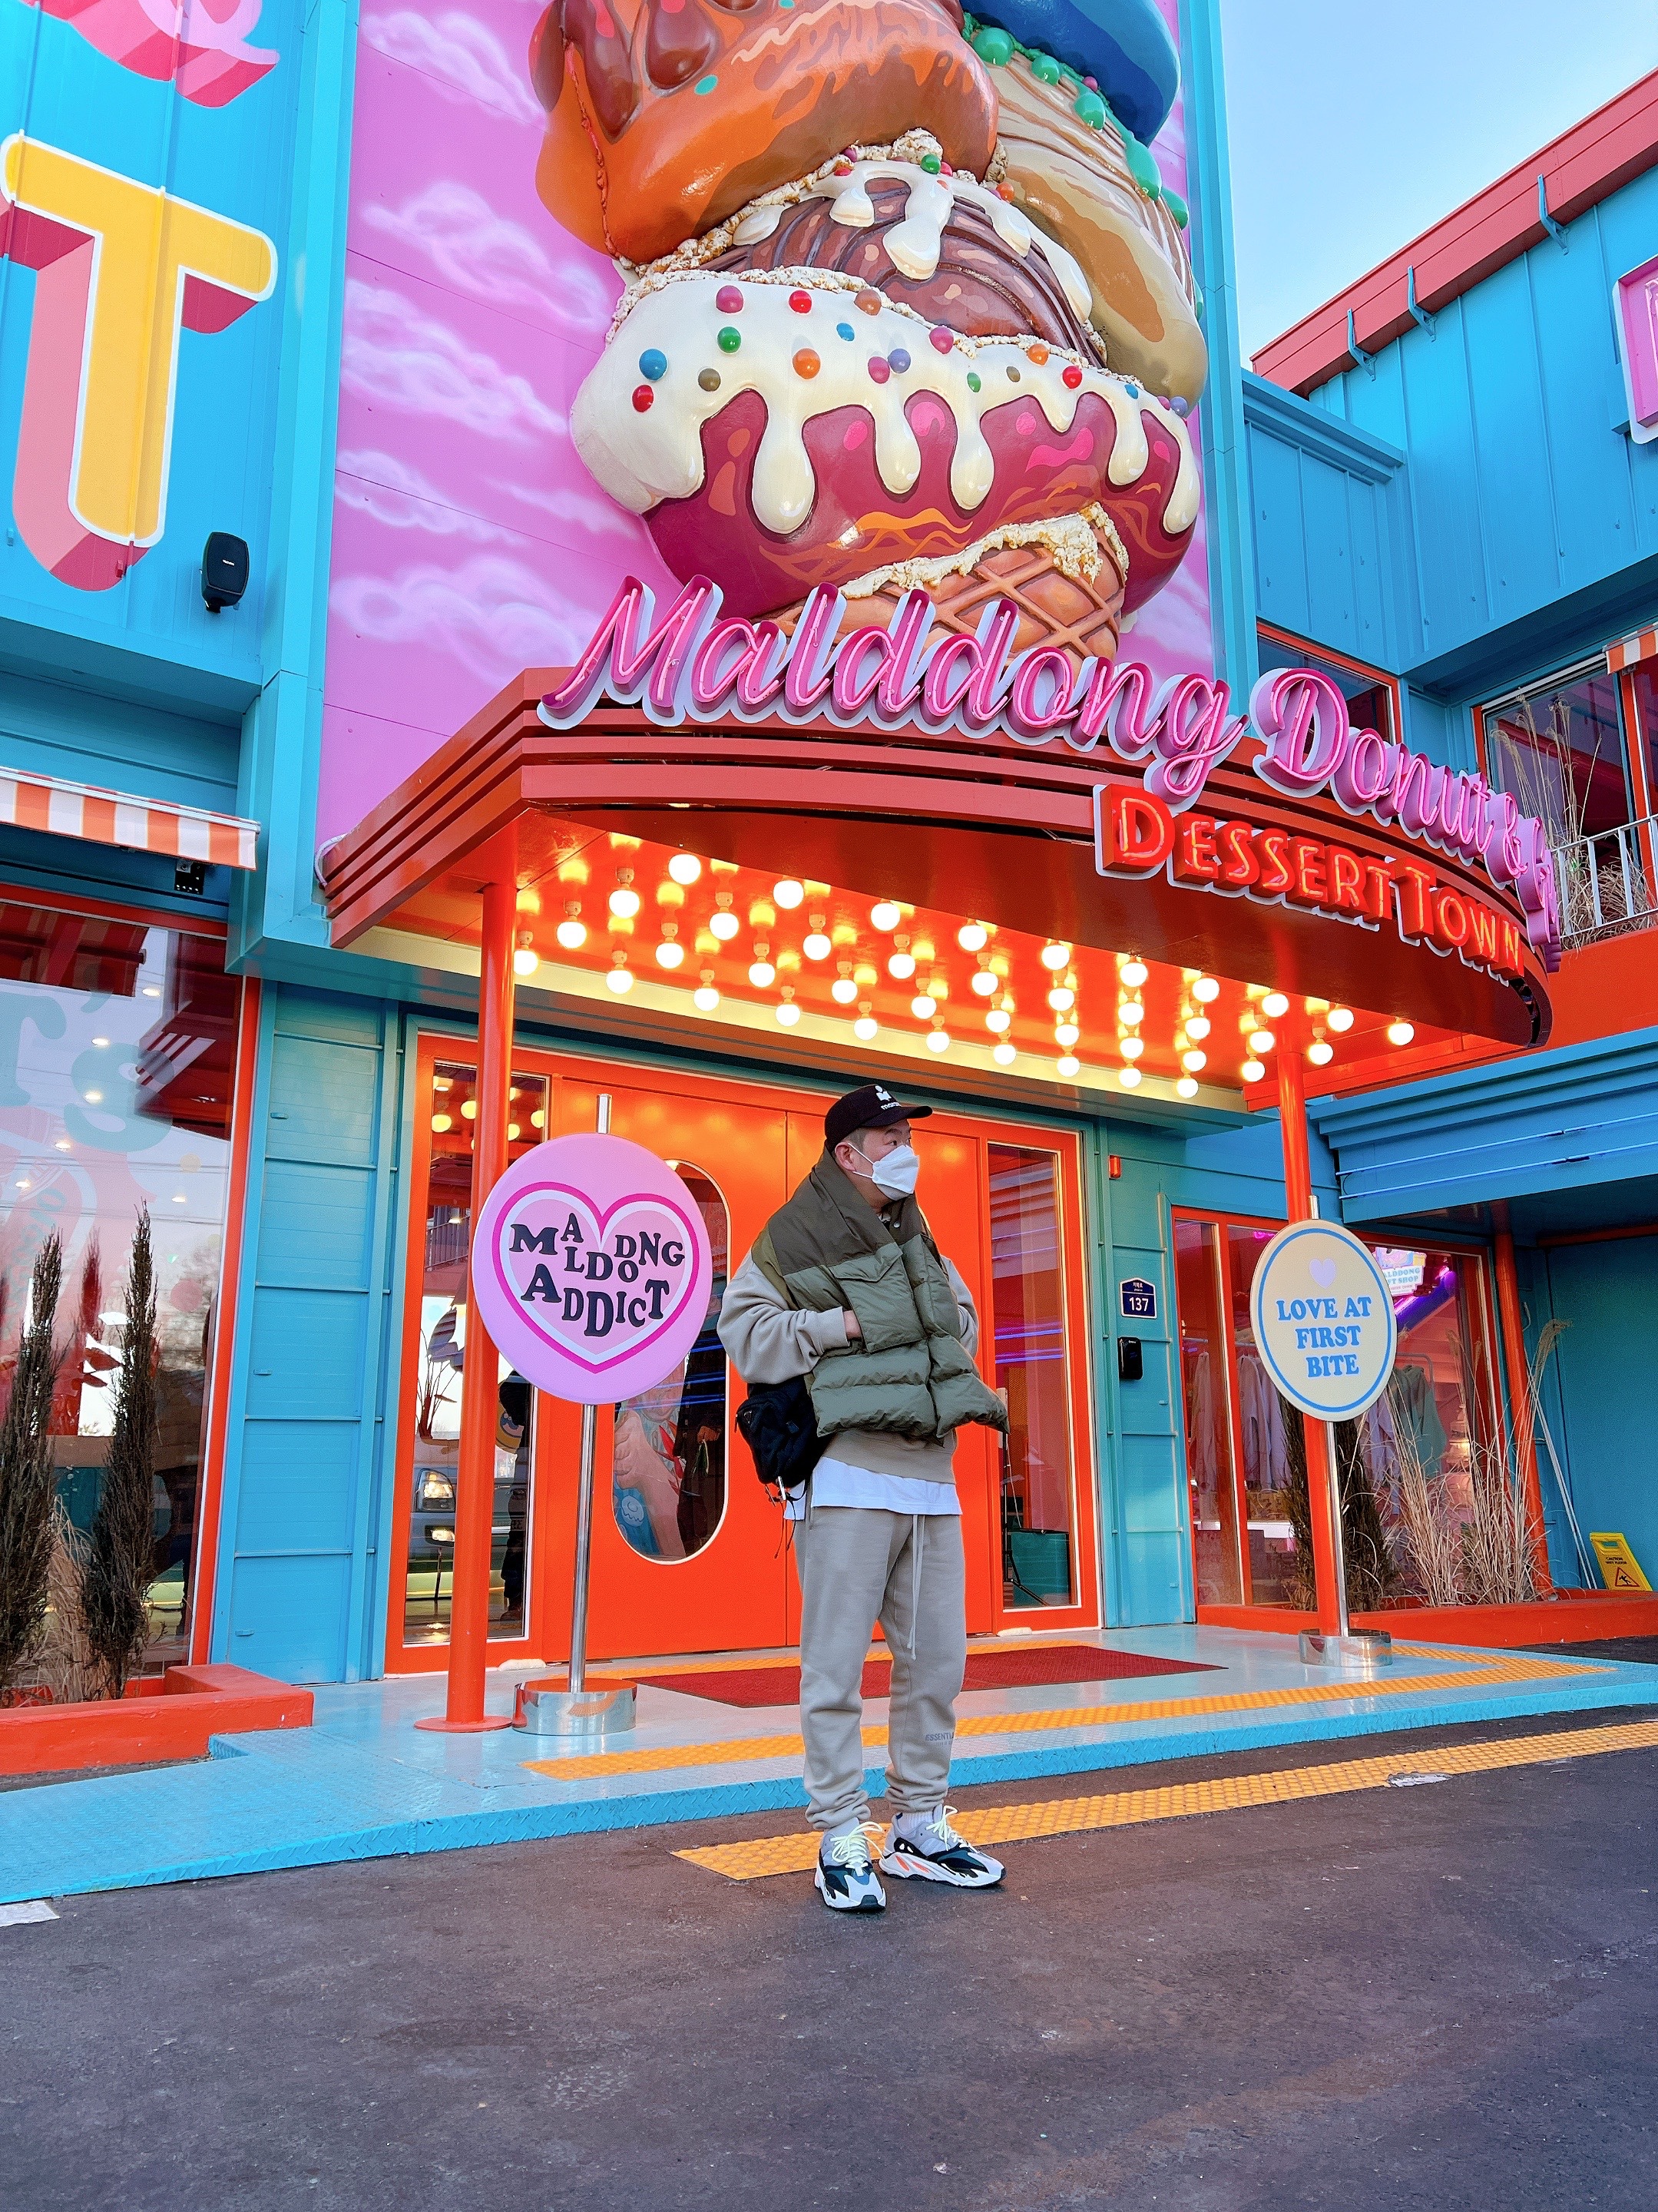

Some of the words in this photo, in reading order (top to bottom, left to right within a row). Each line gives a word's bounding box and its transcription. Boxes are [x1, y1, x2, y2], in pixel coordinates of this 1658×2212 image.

[539, 573, 1250, 804] Malddong
[1253, 667, 1495, 862] Donut
[1488, 791, 1529, 883] &
[1101, 783, 1397, 920] DESSERT
[1395, 856, 1524, 978] TOWN
[509, 1213, 685, 1283] MALDDONG
[520, 1263, 670, 1337] ADDICT
[1129, 1296, 1149, 1312] 137
[1276, 1297, 1338, 1321] LOVE
[1344, 1296, 1372, 1318] AT
[1295, 1325, 1362, 1349] FIRST
[1306, 1353, 1360, 1378] BITE
